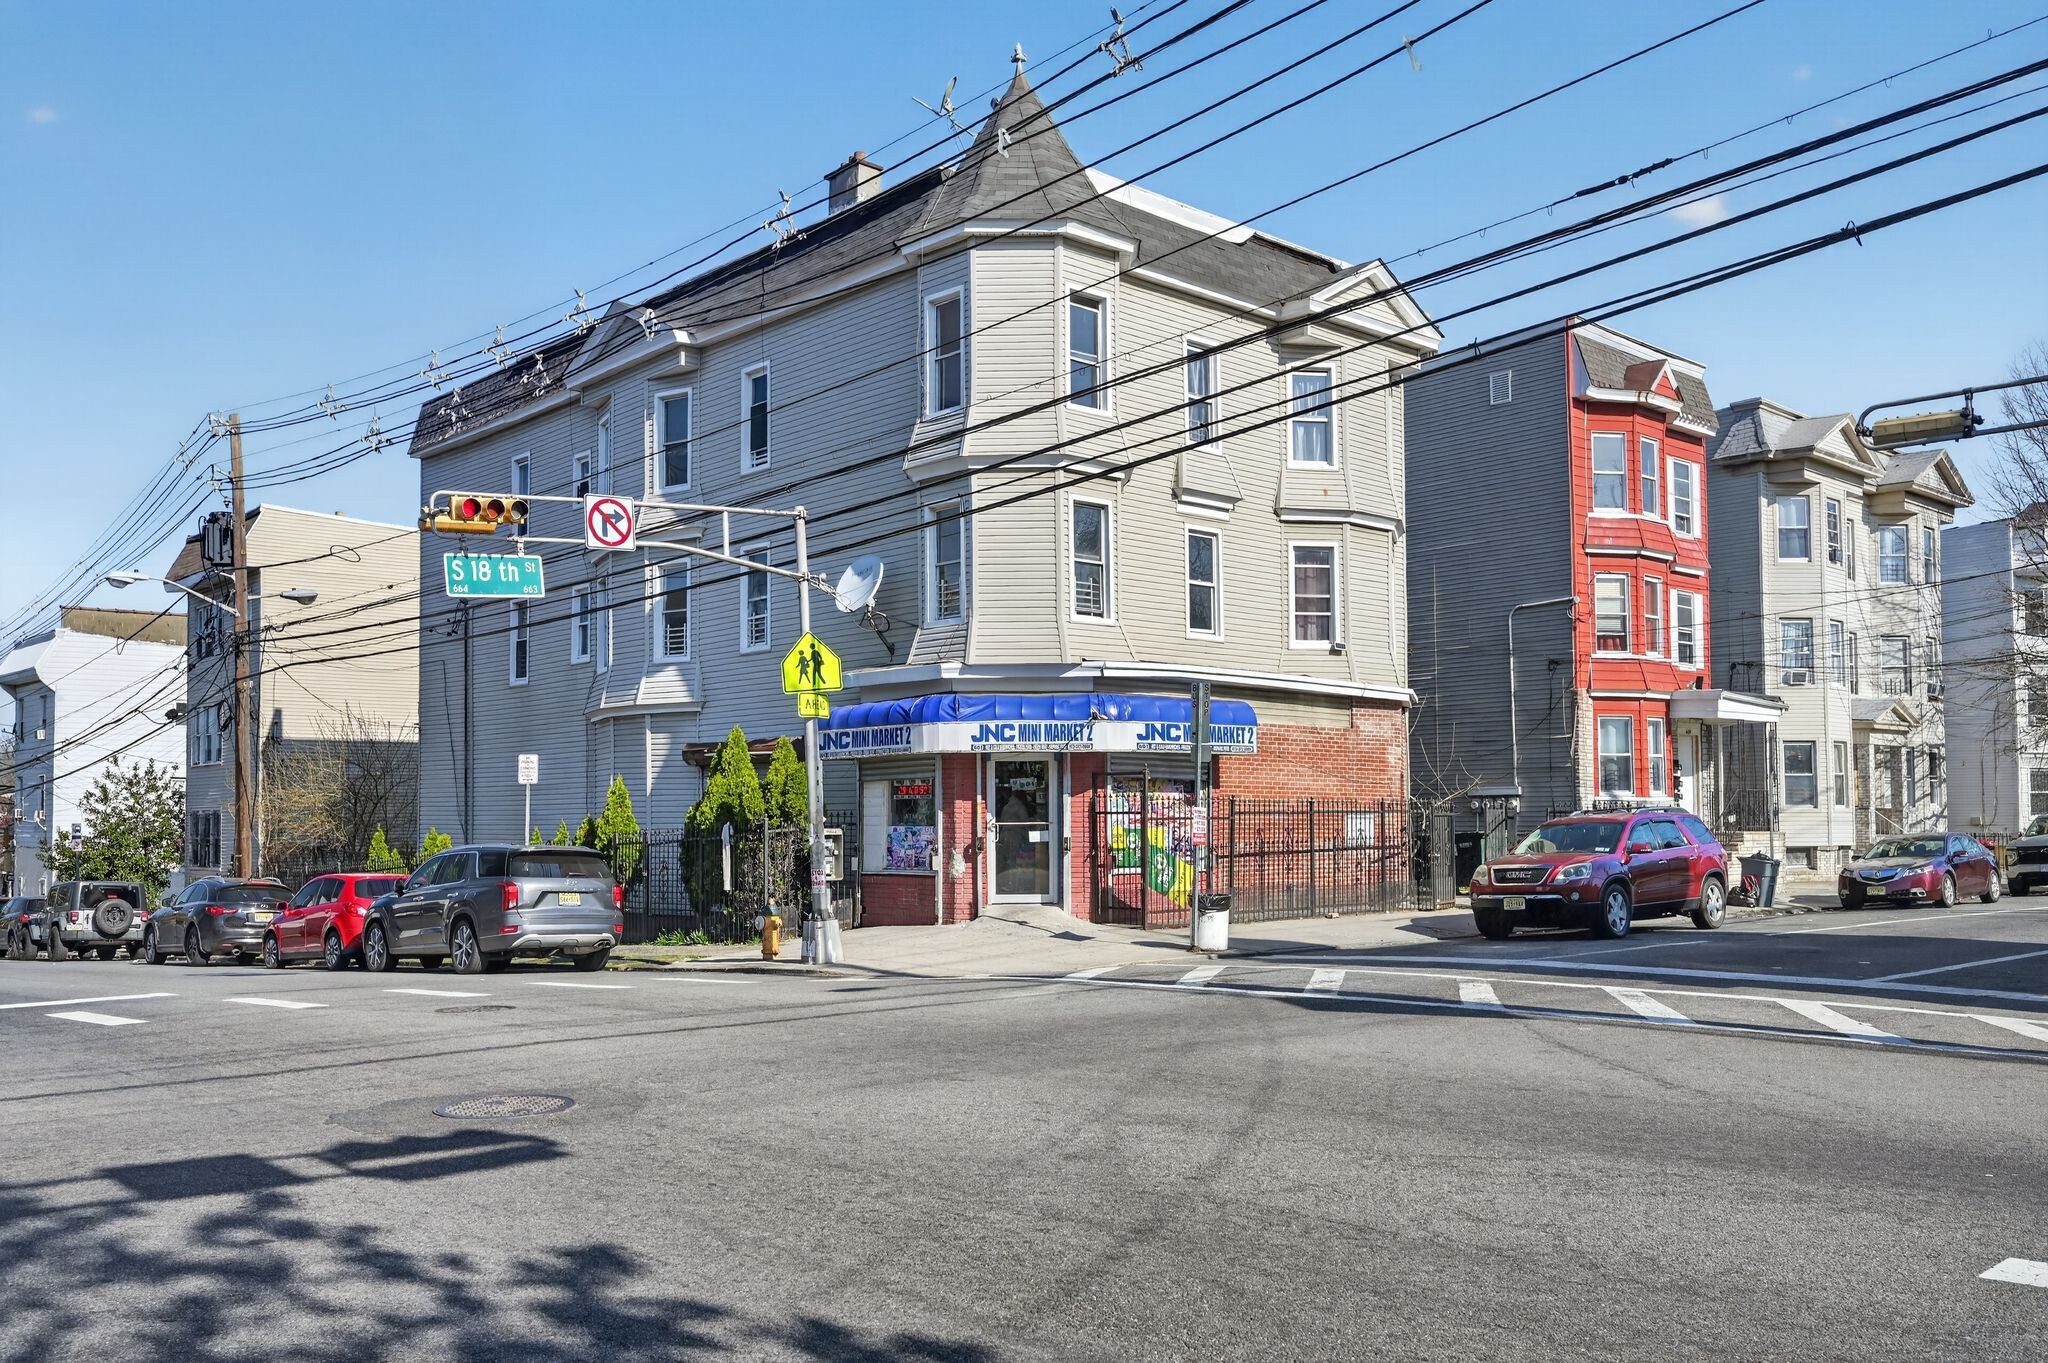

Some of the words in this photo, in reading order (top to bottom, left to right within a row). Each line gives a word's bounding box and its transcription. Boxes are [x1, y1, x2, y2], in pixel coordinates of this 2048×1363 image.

[451, 559, 465, 581] S
[470, 560, 492, 582] 18
[498, 561, 519, 582] th
[525, 562, 536, 573] St
[453, 584, 468, 593] 664
[523, 584, 538, 594] 663
[819, 731, 851, 751] JNC
[851, 730, 870, 749] MINI
[871, 727, 904, 747] MARKET
[905, 726, 912, 745] 2
[970, 723, 1016, 743] JNC
[1018, 723, 1041, 742] MINI
[1044, 723, 1085, 742] MARKET
[1086, 724, 1094, 742] 2
[1136, 723, 1182, 742] JNC
[1209, 725, 1247, 744] MARKET
[1247, 727, 1255, 744] 2
